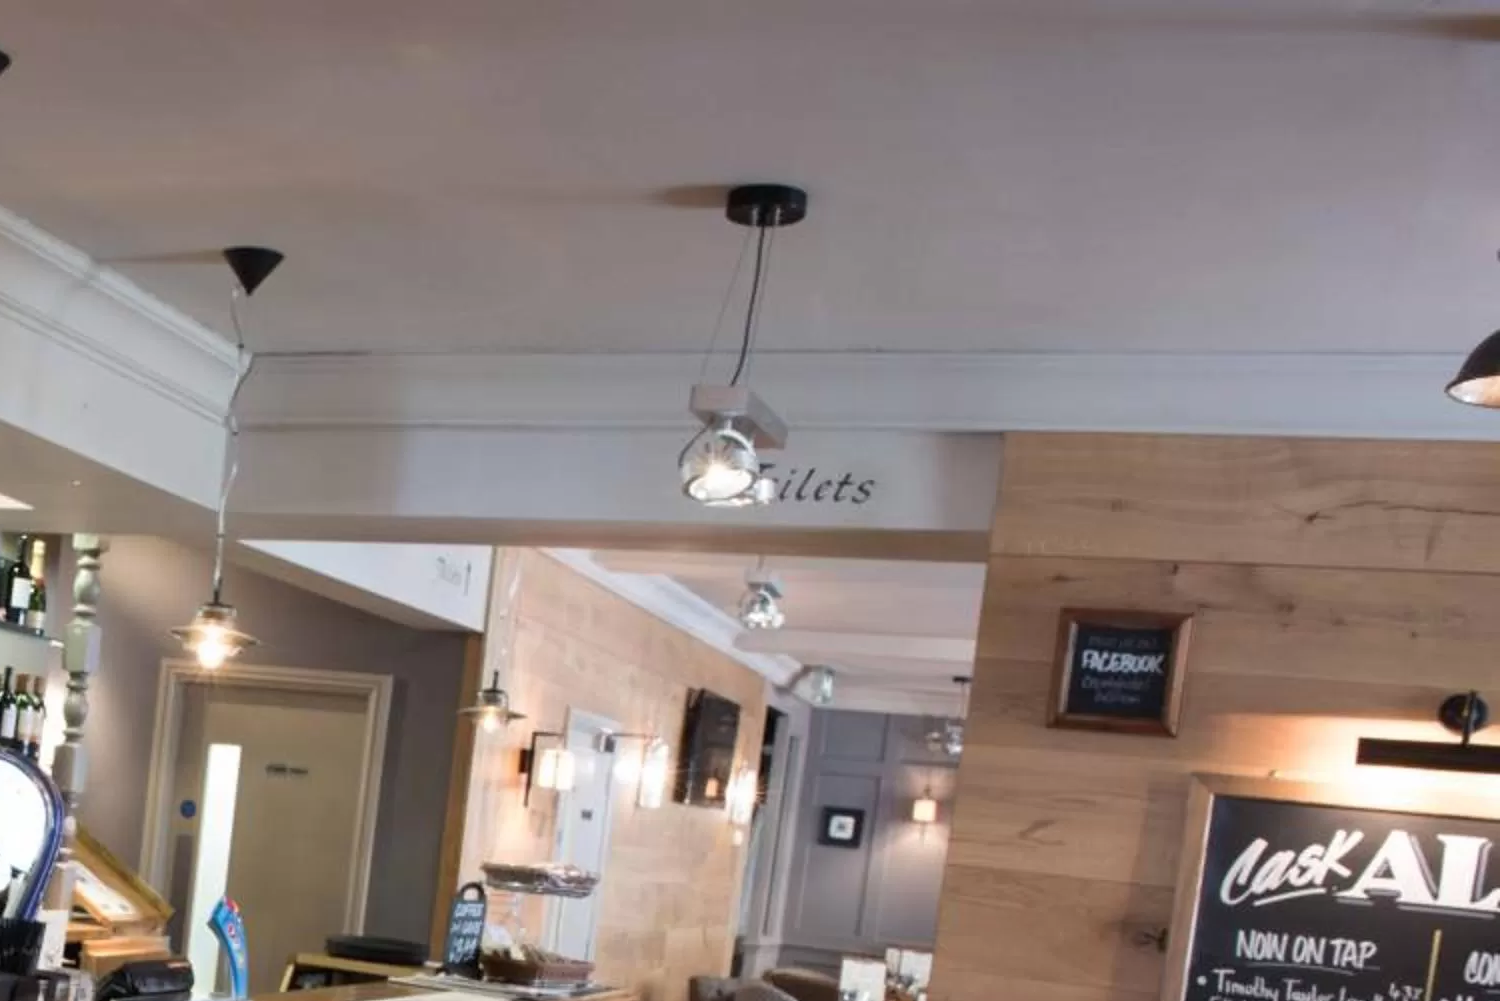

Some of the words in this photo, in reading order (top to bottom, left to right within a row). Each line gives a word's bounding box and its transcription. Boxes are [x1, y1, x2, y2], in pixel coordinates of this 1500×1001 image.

[1081, 649, 1164, 673] FACEBOOK
[1220, 829, 1364, 905] Cask
[1236, 930, 1288, 961] NOW
[1292, 936, 1326, 964] ON
[1331, 938, 1377, 968] TAP
